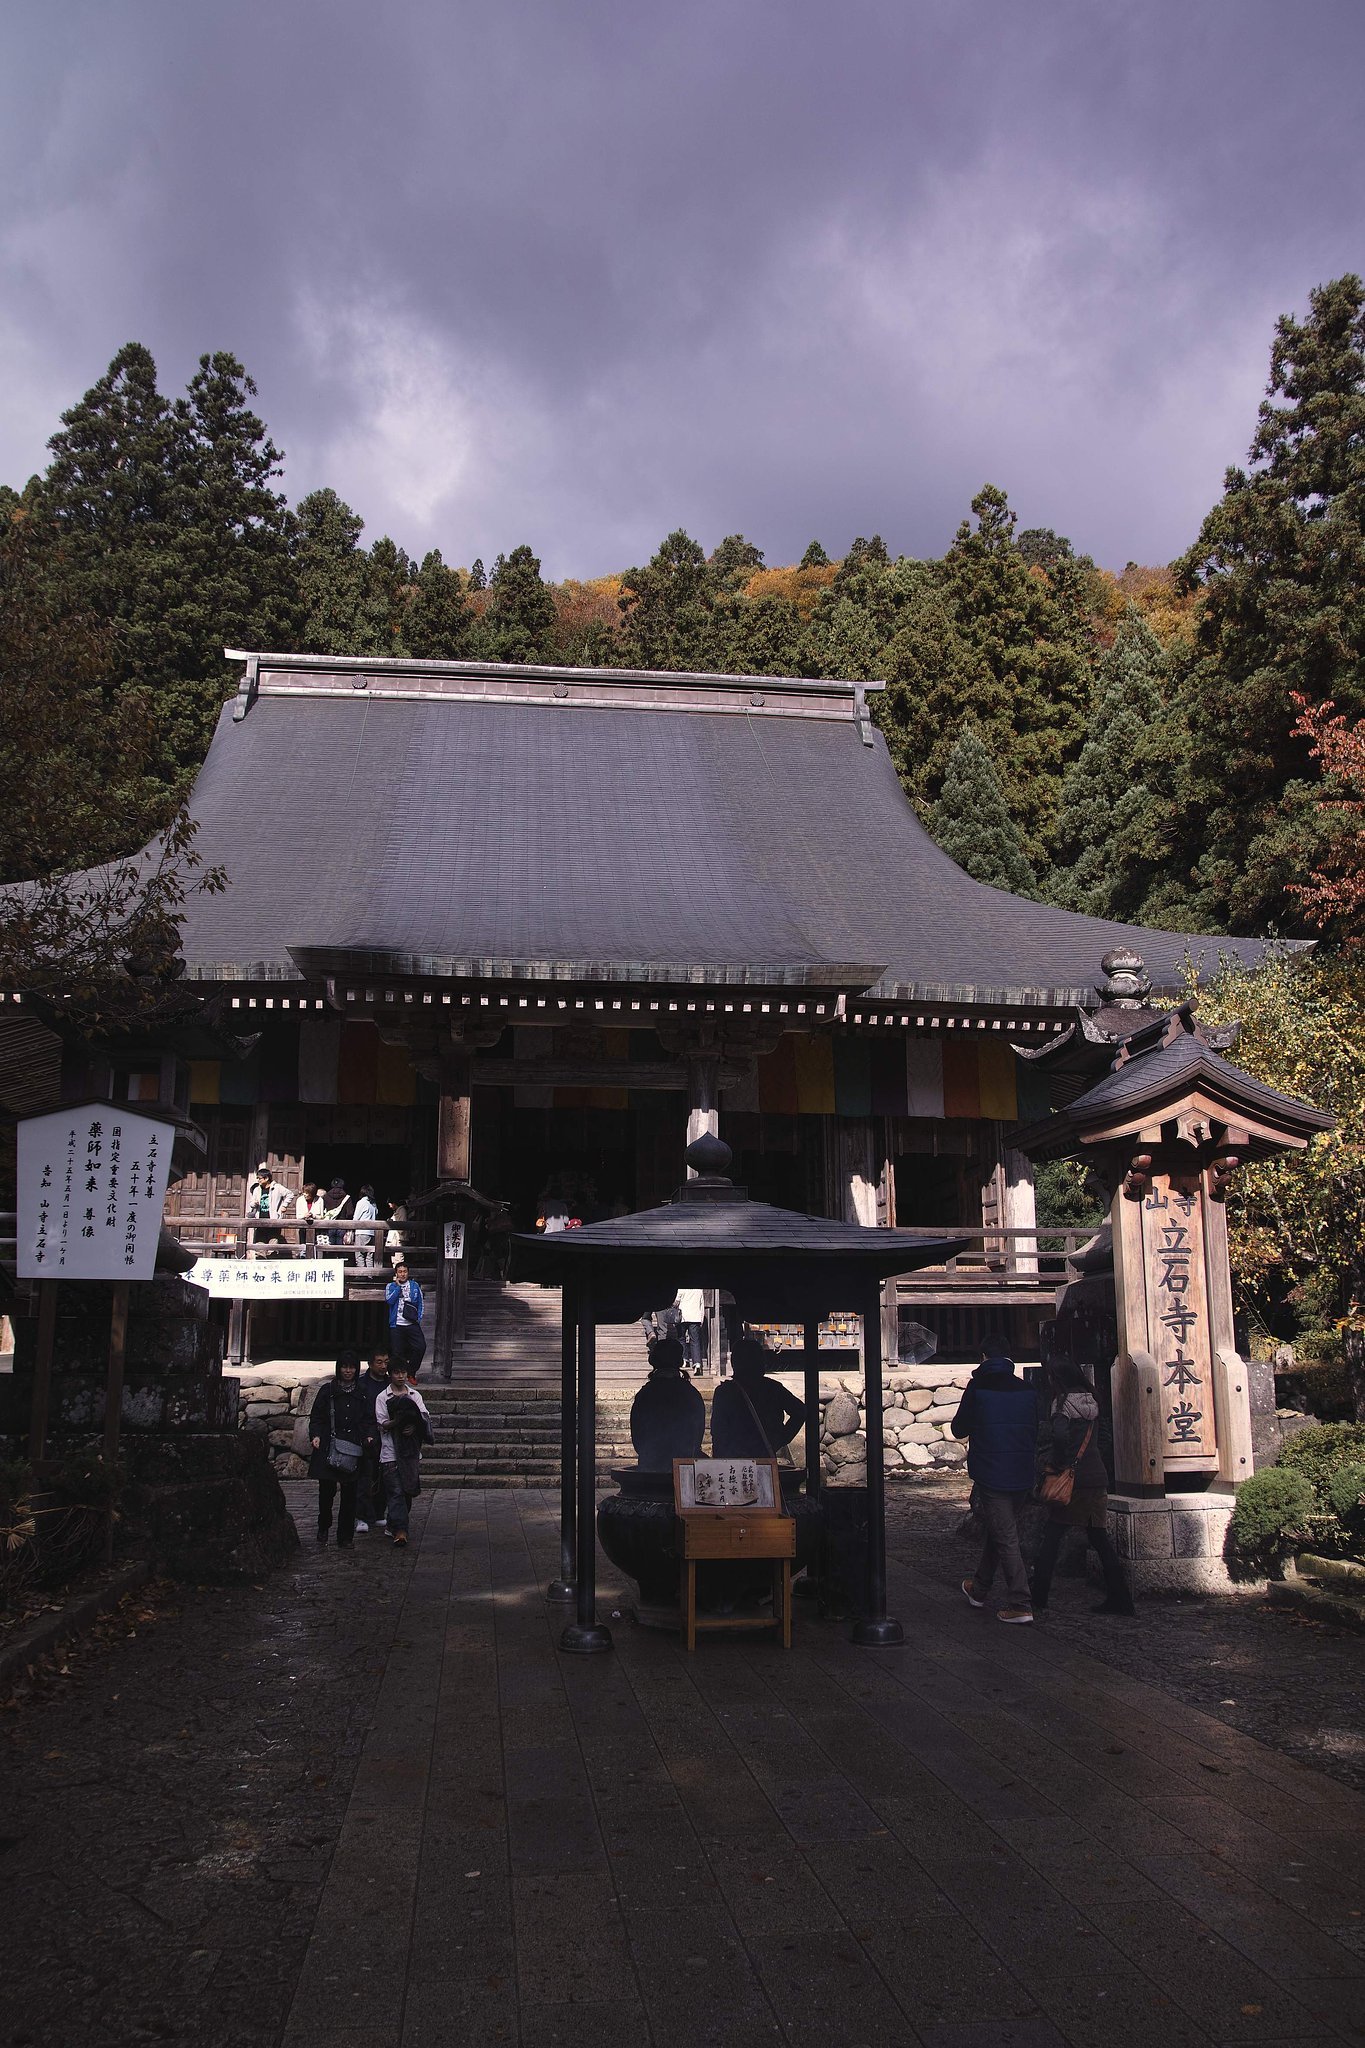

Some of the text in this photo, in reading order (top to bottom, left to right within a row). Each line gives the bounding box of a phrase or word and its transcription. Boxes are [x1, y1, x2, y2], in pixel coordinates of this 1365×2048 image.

[144, 1134, 159, 1199] 立石寺本尊
[1145, 1185, 1198, 1217] 山寺
[1156, 1217, 1204, 1444] 立石寺本堂
